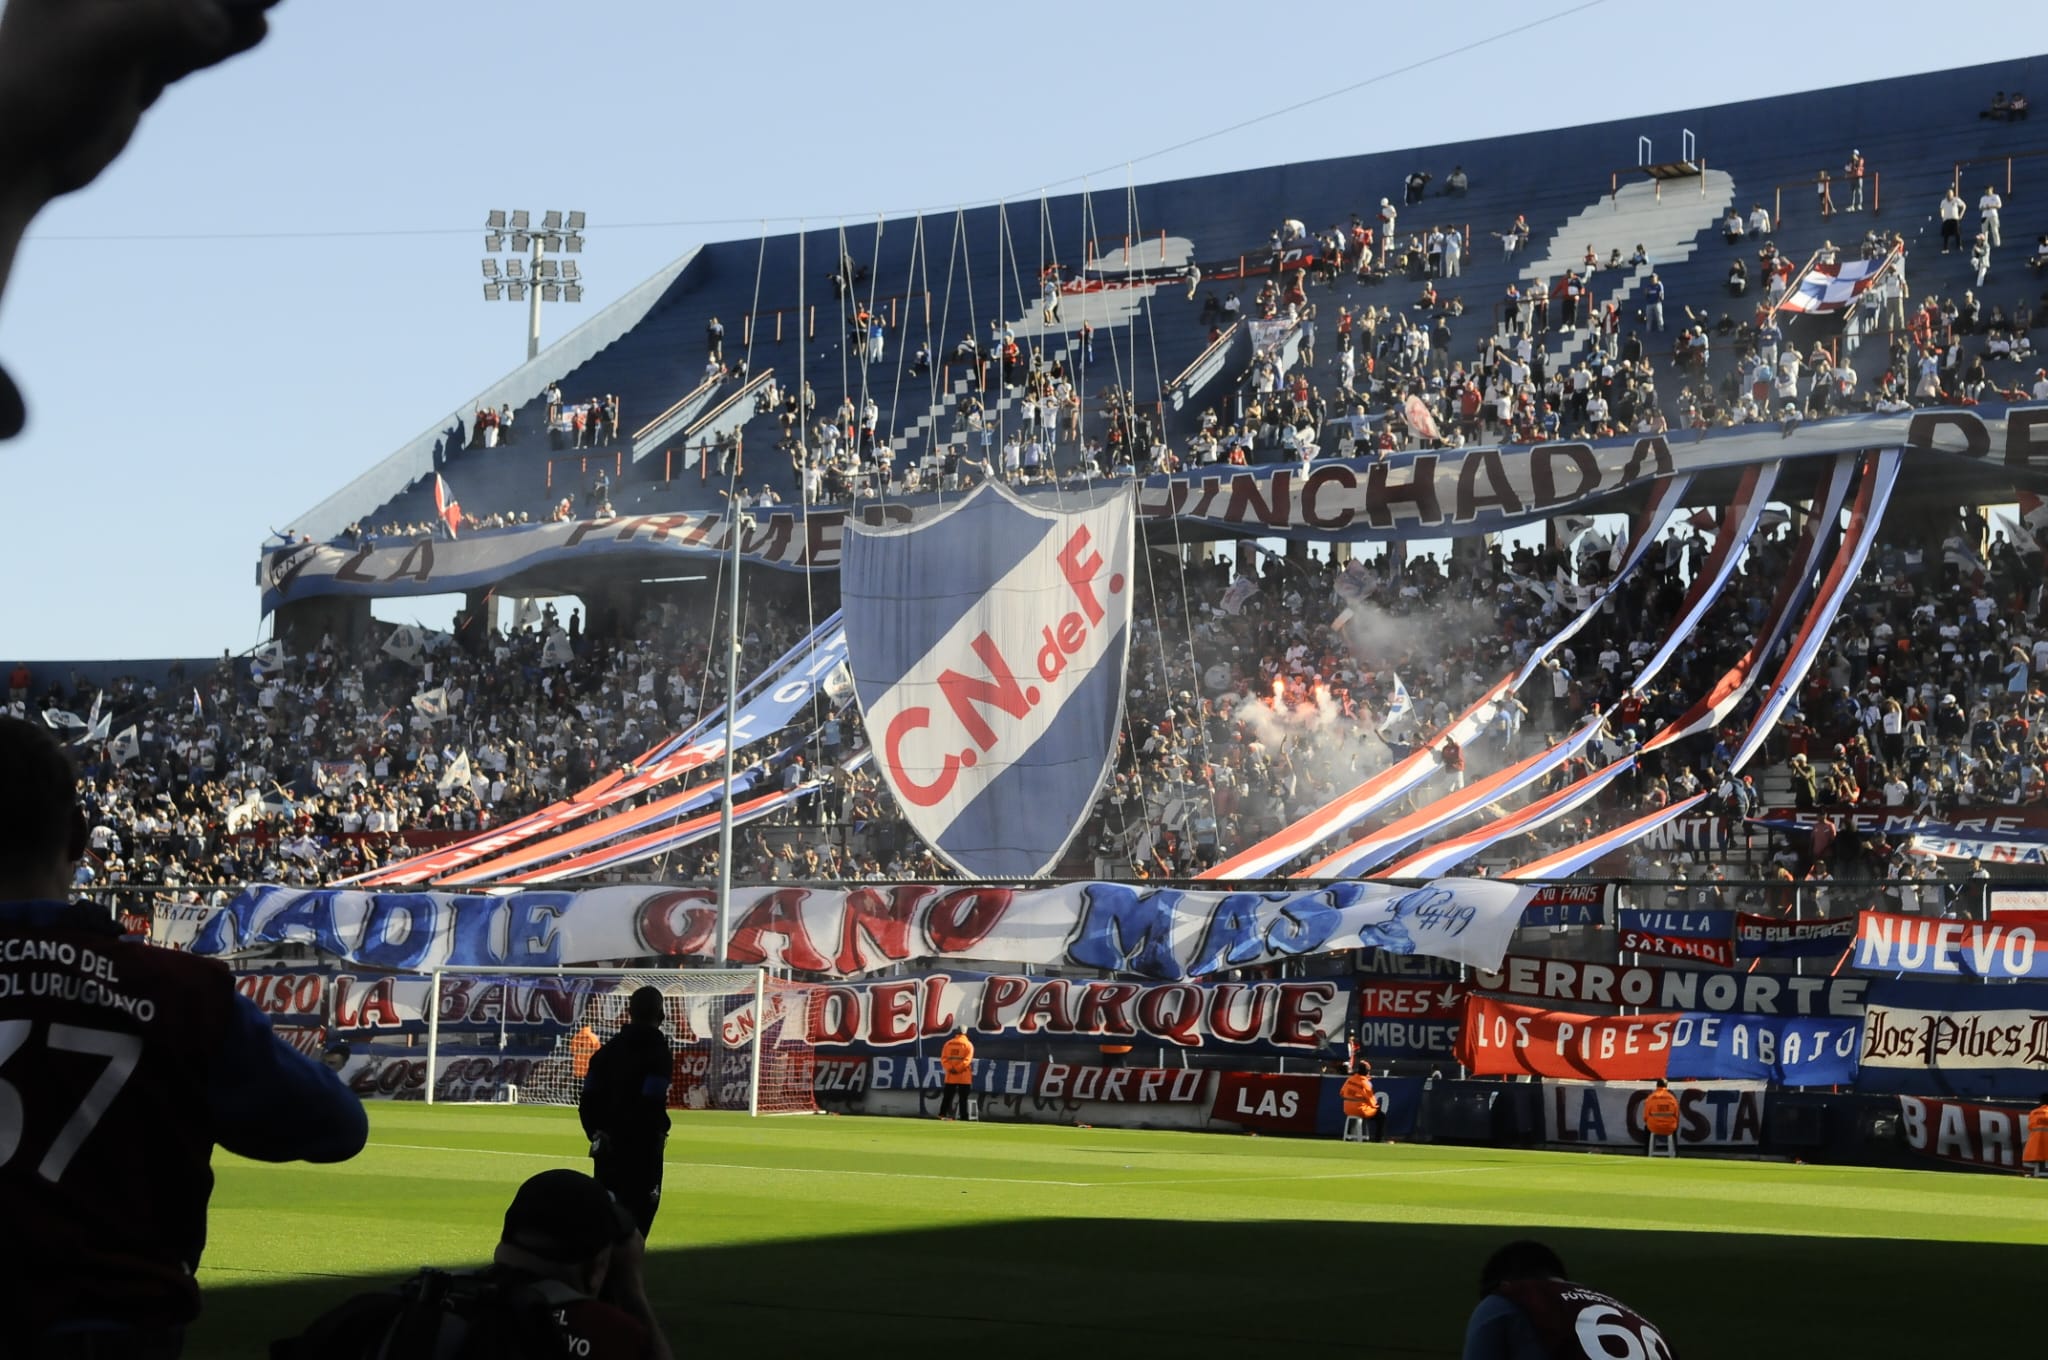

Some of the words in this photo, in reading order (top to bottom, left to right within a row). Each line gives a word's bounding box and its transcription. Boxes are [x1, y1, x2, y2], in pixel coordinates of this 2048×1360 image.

[334, 538, 436, 584] LA
[1639, 912, 1711, 931] VILLA
[80, 949, 120, 983] DEL
[1860, 916, 2036, 976] NUEVO
[334, 974, 402, 1030] LA
[803, 973, 954, 1047] DEL
[976, 974, 1338, 1049] PARQUE
[1362, 987, 1433, 1014] TRES
[1661, 970, 1870, 1016] NORTE
[1478, 1013, 1533, 1049] LOS
[1556, 1021, 1671, 1060] PIBES
[1671, 1018, 1721, 1048] DE
[1731, 1024, 1857, 1066] ABAJO
[1040, 1063, 1201, 1102] BORRO
[1236, 1087, 1299, 1119] LAS
[1555, 1086, 1607, 1142] LA
[1626, 1087, 1761, 1145] CSTA
